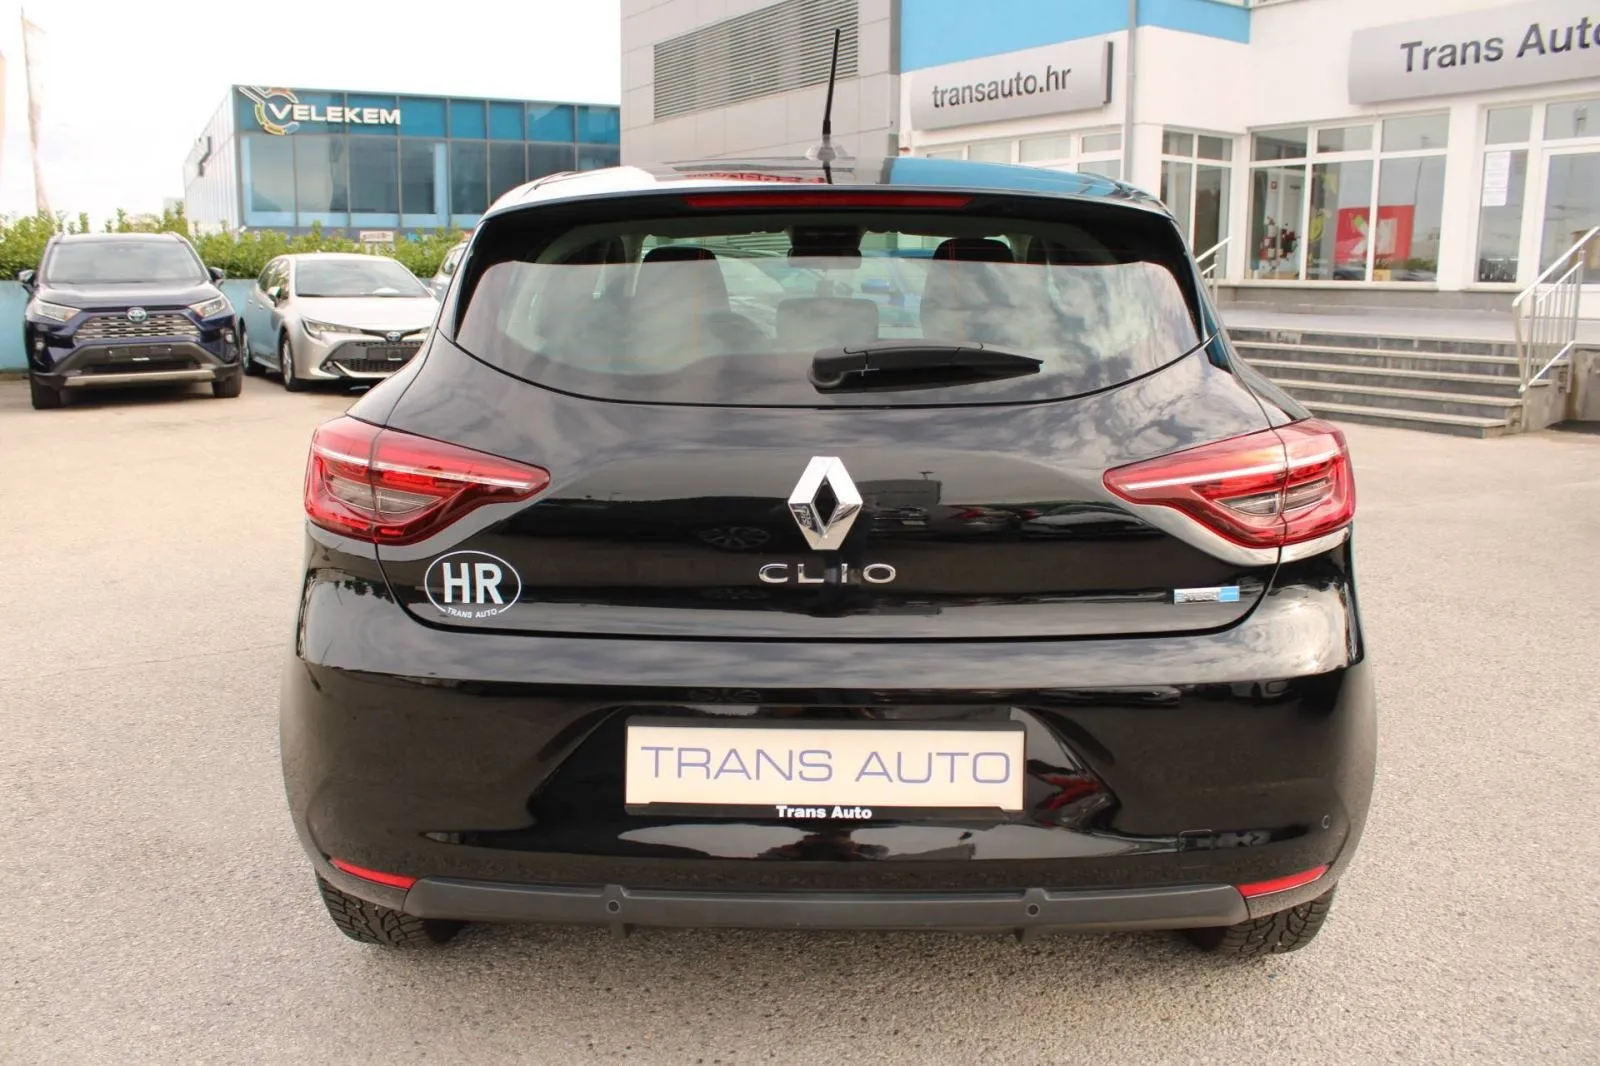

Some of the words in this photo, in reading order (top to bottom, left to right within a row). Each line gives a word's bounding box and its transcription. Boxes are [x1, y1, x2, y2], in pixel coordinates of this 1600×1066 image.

[1400, 37, 1504, 72] Trans
[932, 65, 1072, 108] transauto.hr
[268, 103, 401, 124] VELEKEM
[442, 562, 504, 605] HR
[758, 563, 896, 583] CLIO
[447, 607, 472, 618] TRANS
[475, 608, 498, 618] AUTO
[641, 746, 833, 783] TRANS
[855, 751, 1010, 784] AUTO
[776, 805, 827, 818] Trans
[831, 806, 873, 819] Auto
